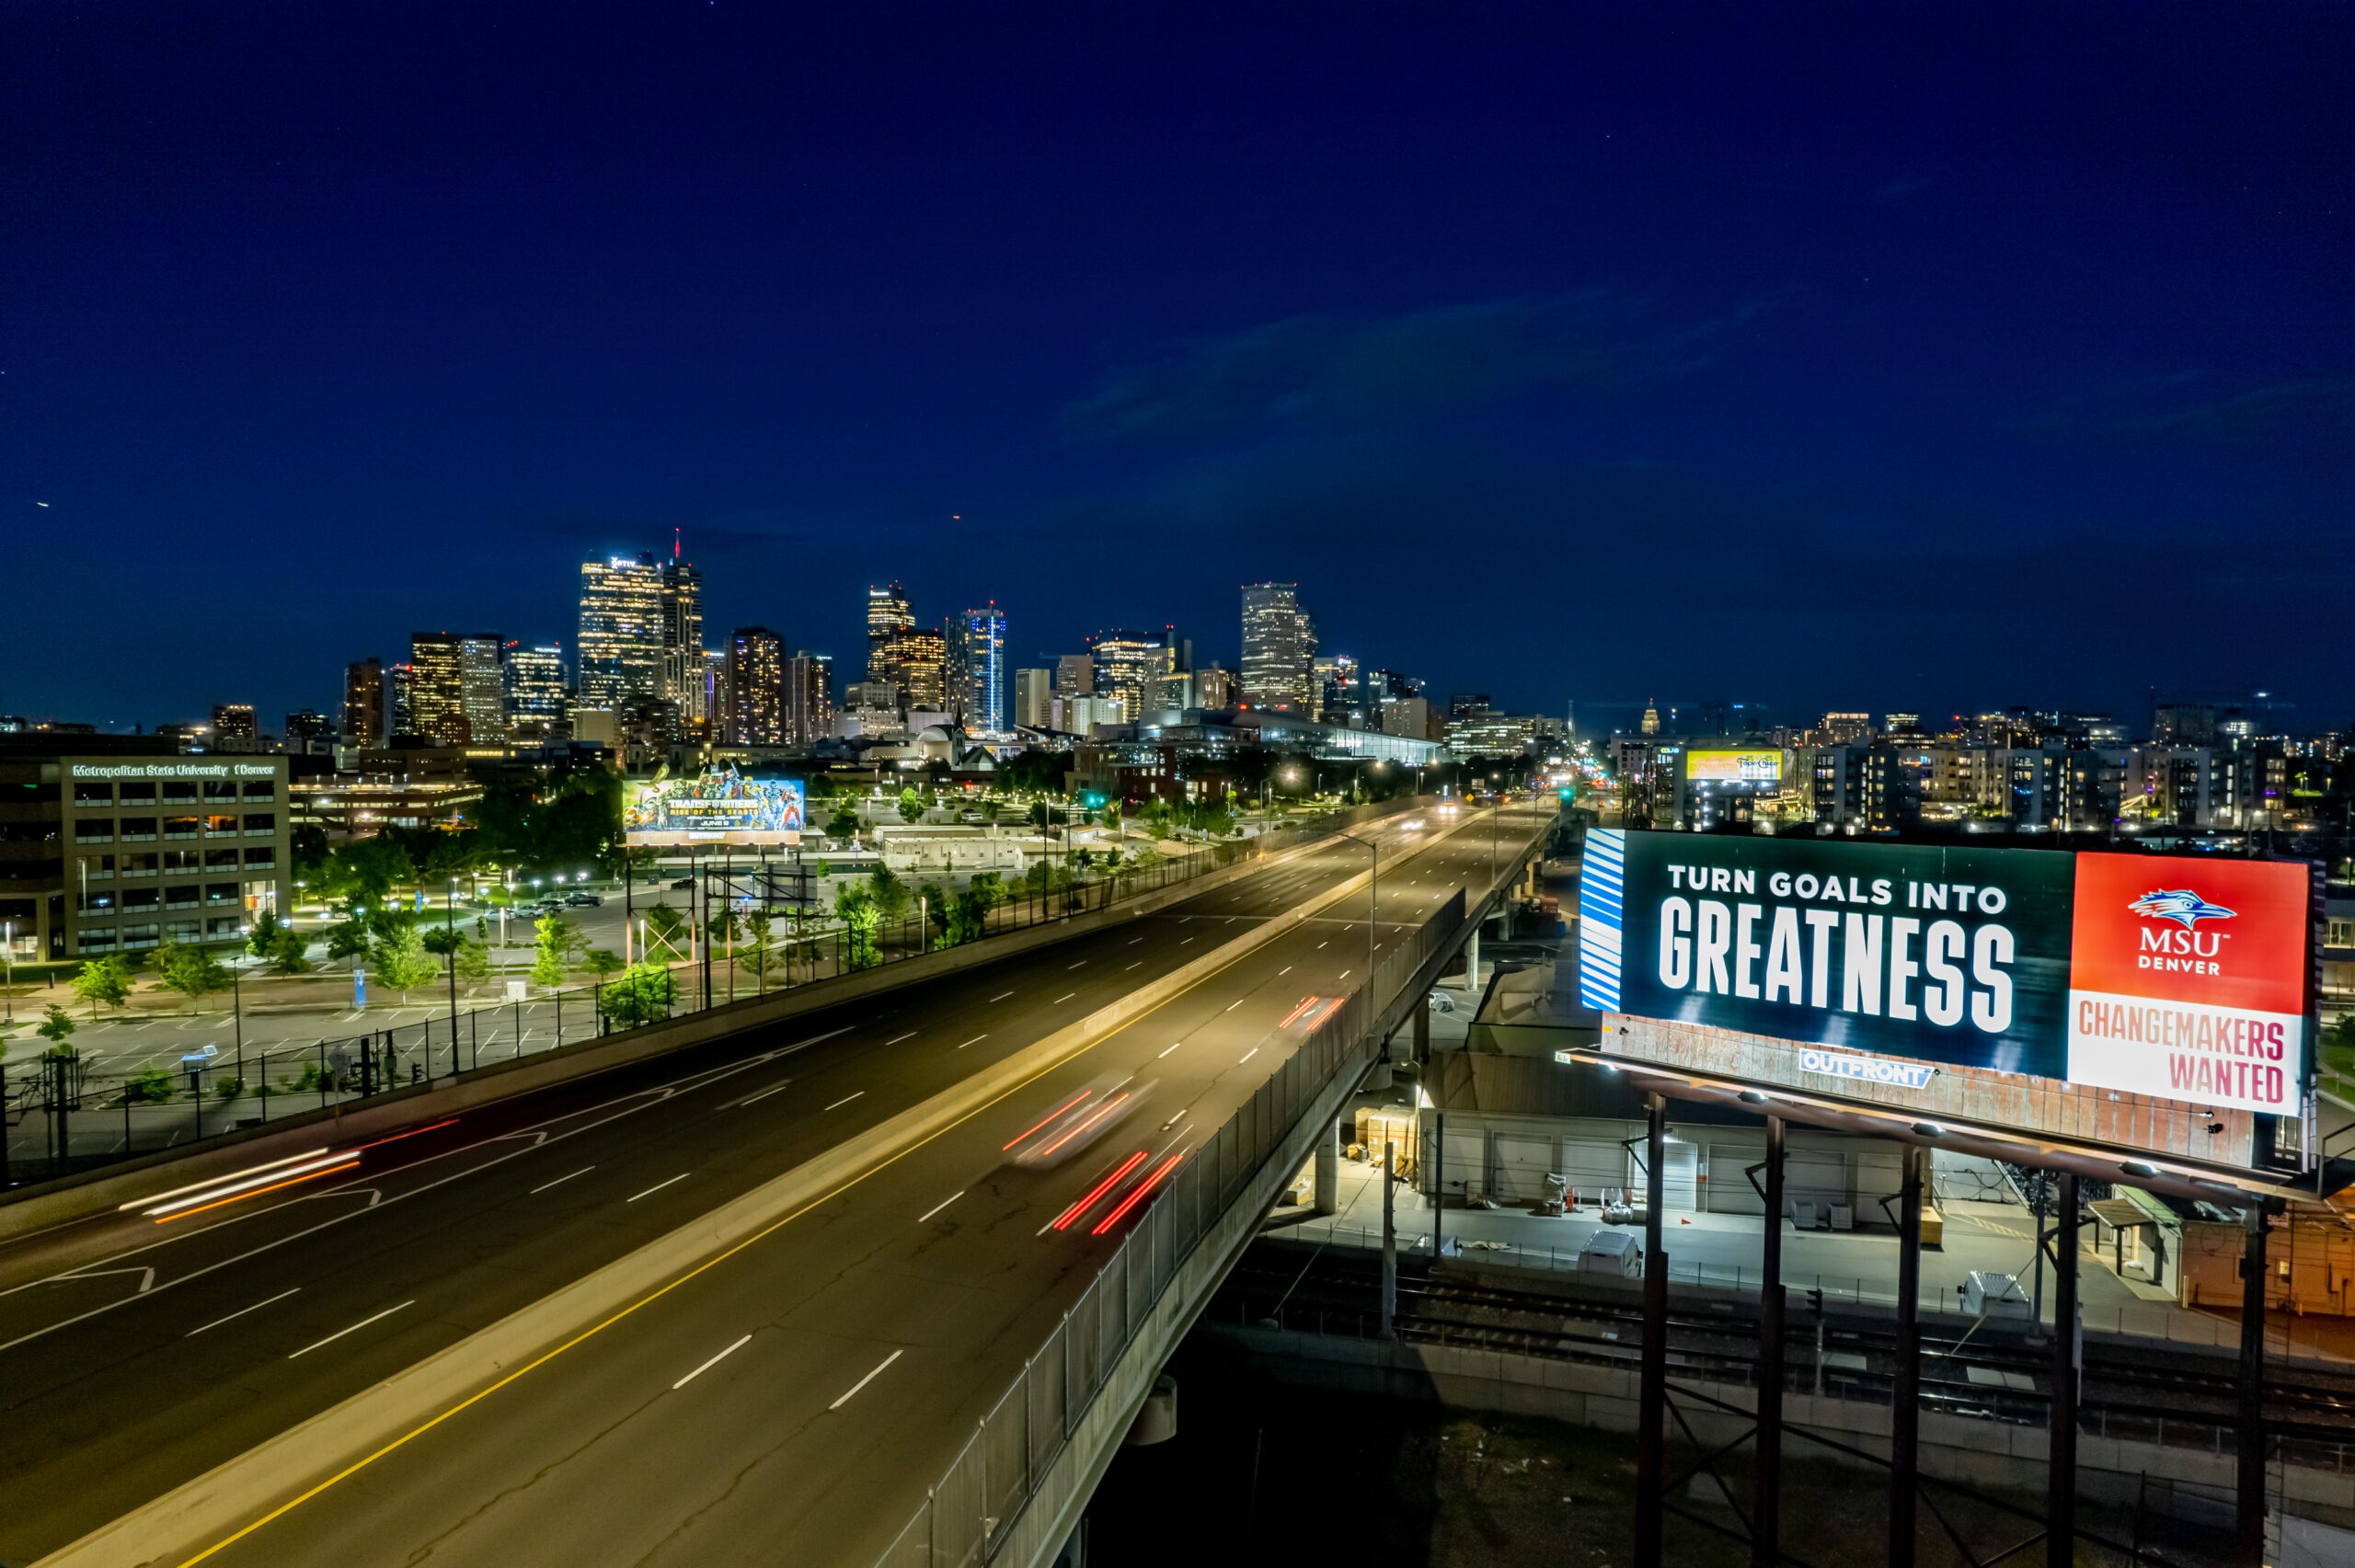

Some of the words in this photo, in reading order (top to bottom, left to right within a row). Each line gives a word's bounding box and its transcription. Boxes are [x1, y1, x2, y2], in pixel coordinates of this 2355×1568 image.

[73, 764, 145, 778] Metropolitan
[146, 764, 176, 776] State
[177, 764, 229, 777] University
[240, 764, 275, 776] Denver
[1667, 864, 1755, 895] TURN
[1769, 871, 1893, 906] GOALS
[1908, 880, 2007, 915] INTO
[1659, 896, 2015, 1034] GREATNESS
[2138, 955, 2221, 976] DENVER
[2079, 1000, 2284, 1061] CHANGEMAKERS
[1803, 1051, 1926, 1085] OUTFRONT
[2168, 1052, 2283, 1104] WANTED
